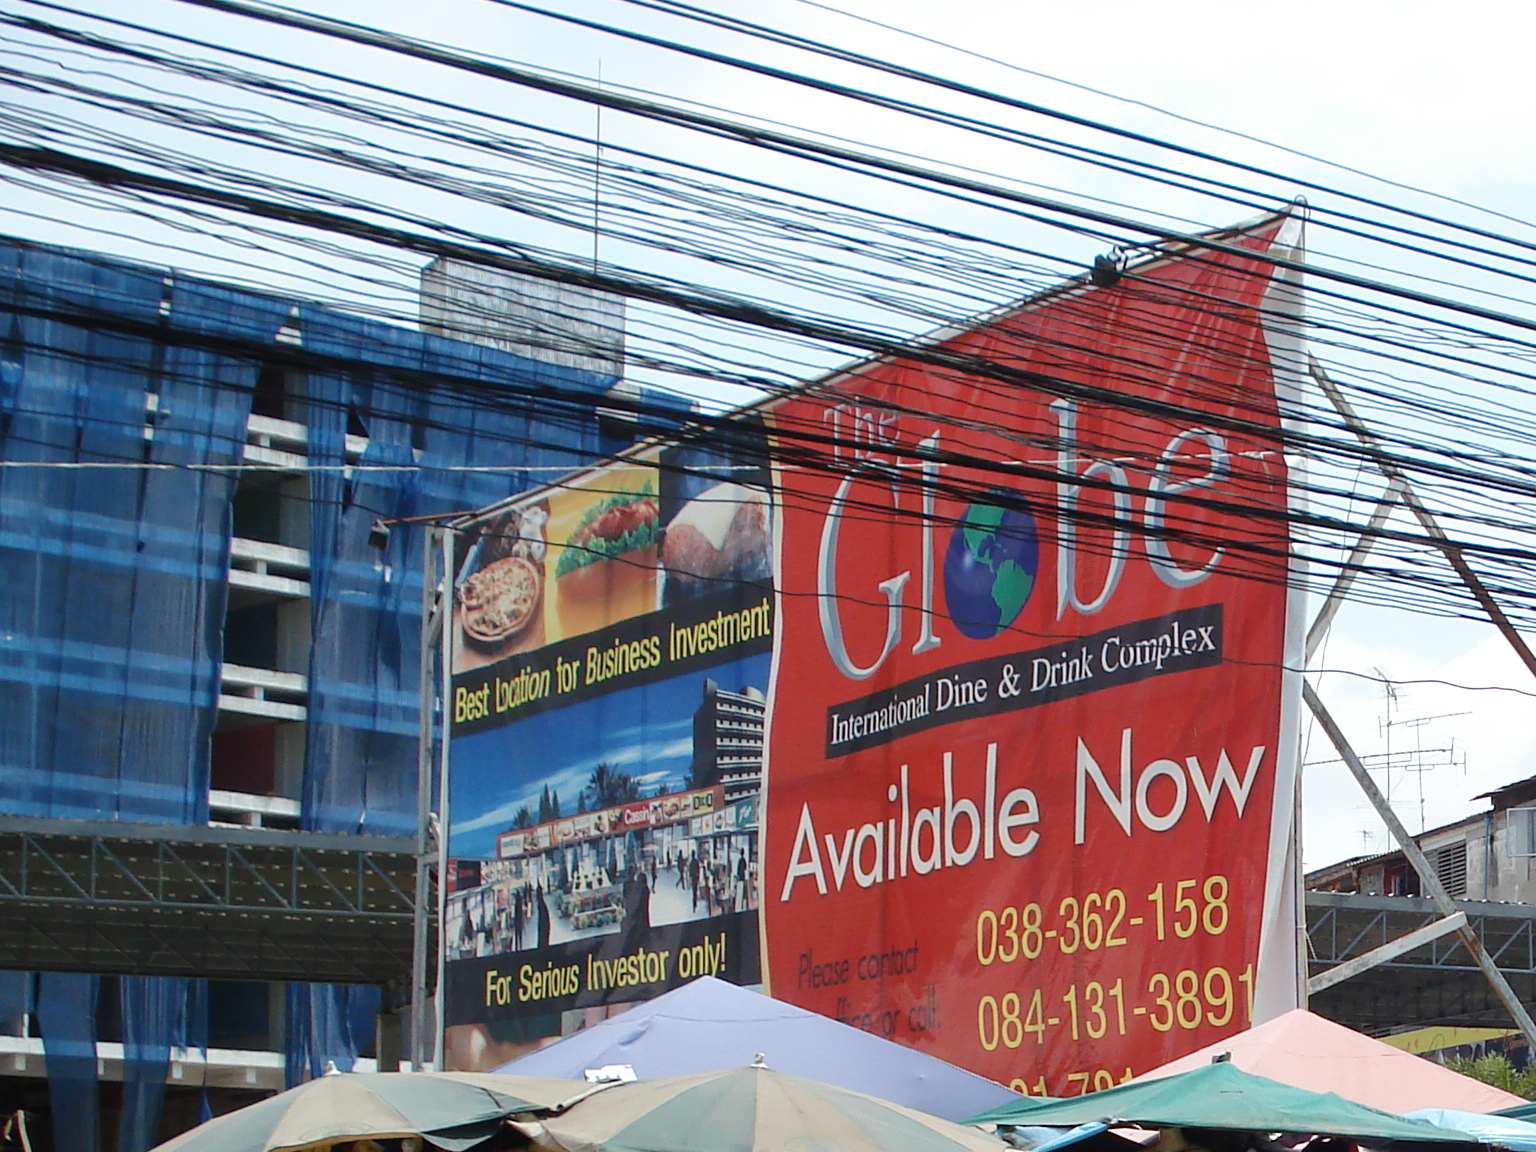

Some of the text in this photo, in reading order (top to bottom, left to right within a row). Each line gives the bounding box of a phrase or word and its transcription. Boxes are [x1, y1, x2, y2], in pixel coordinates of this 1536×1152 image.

[455, 598, 770, 723] Best Location for Business Investment
[831, 621, 1216, 745] International Dine & Drink Complex
[781, 727, 1266, 901] Available Now
[798, 939, 919, 989] Please contact
[976, 875, 1229, 966] 038-362-158
[485, 932, 727, 1007] For Serious Investor only!
[977, 963, 1255, 1051] 084-131-3891
[882, 1009, 900, 1035] or
